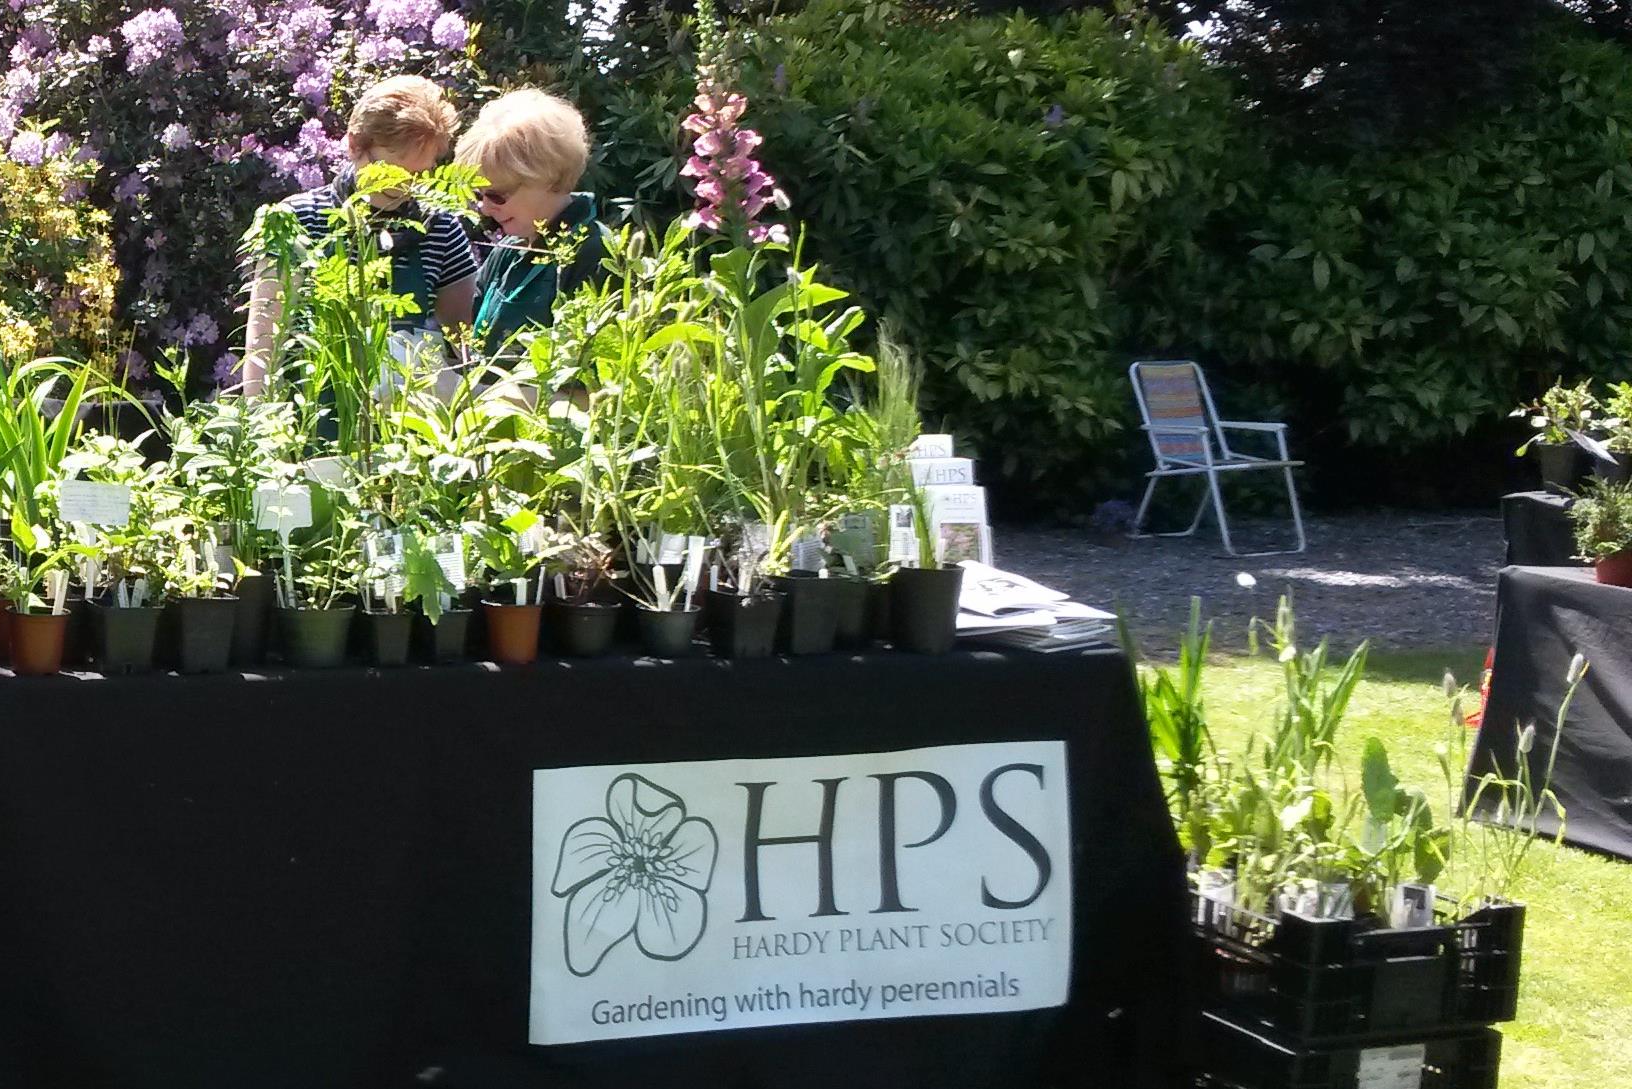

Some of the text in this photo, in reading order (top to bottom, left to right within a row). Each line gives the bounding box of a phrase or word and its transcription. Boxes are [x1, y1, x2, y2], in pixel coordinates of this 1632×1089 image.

[936, 467, 966, 481] HPS
[734, 763, 1051, 923] HPS
[733, 918, 1055, 960] HARDY PLANT SOCIETY
[591, 971, 1020, 1026] Gardening with hardy perennials
